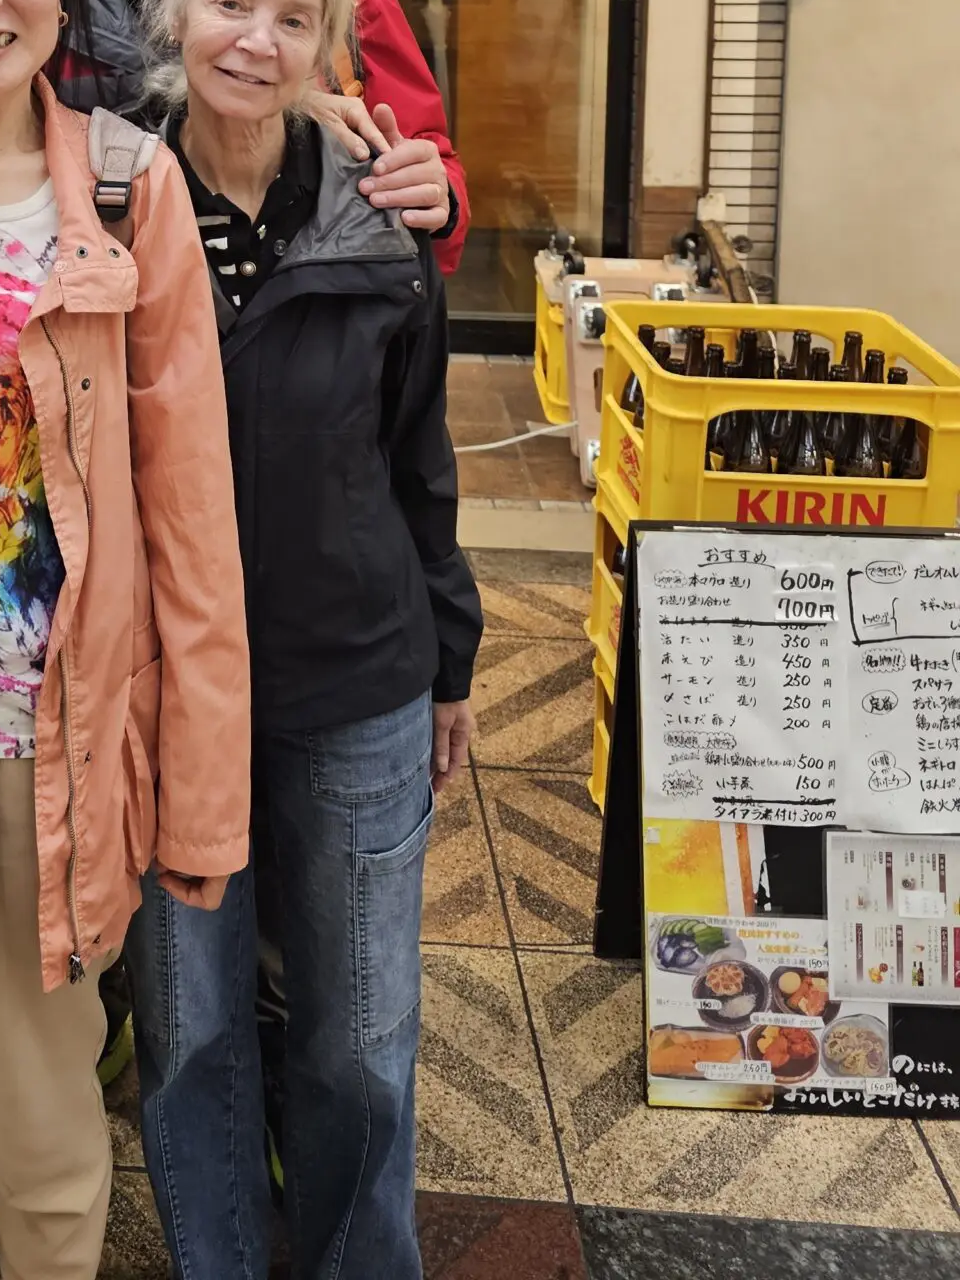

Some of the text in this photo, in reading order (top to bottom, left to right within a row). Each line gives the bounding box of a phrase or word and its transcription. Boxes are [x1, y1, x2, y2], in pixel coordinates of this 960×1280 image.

[737, 488, 887, 527] KIRIN
[703, 547, 767, 563] おすすめ
[780, 569, 834, 591] 600円
[777, 597, 835, 620] 700円
